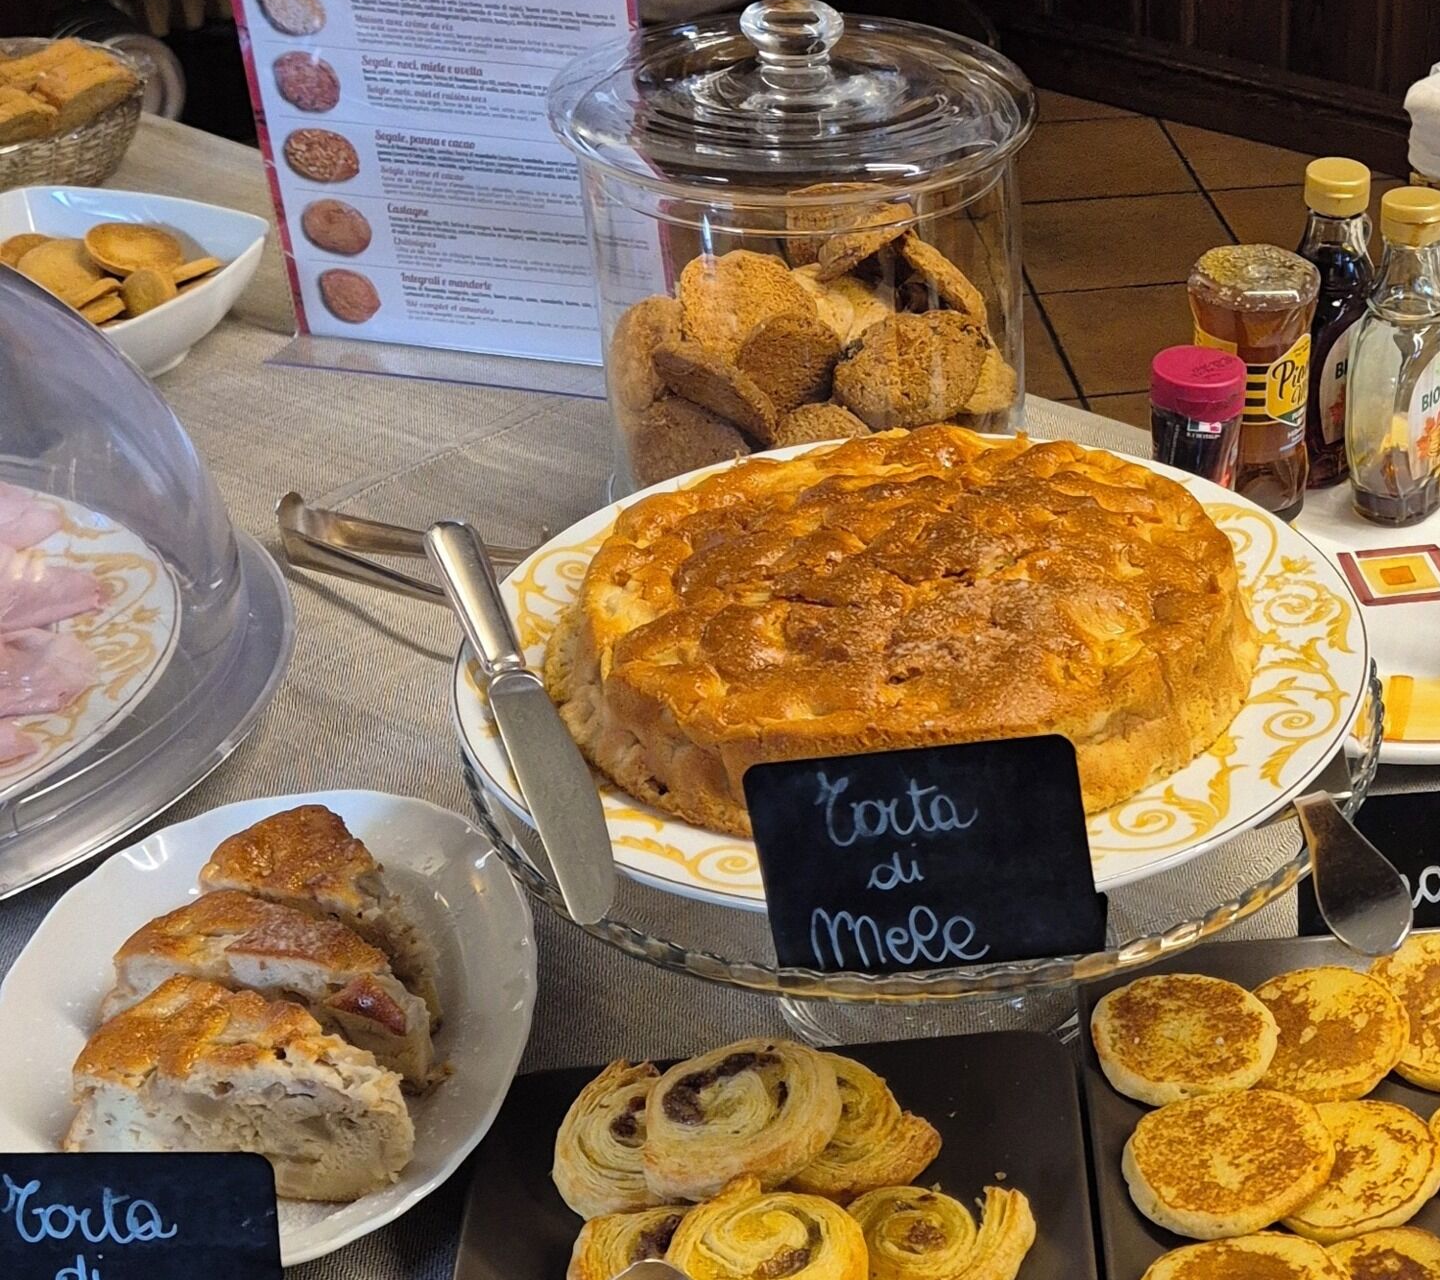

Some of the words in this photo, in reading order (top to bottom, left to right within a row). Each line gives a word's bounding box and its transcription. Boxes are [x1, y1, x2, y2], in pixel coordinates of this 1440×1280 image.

[1334, 358, 1348, 380] BI
[1421, 385, 1440, 412] BIO
[814, 772, 978, 847] Torta
[866, 842, 924, 890] di
[811, 905, 991, 969] Mele
[2, 1173, 178, 1245] Torta
